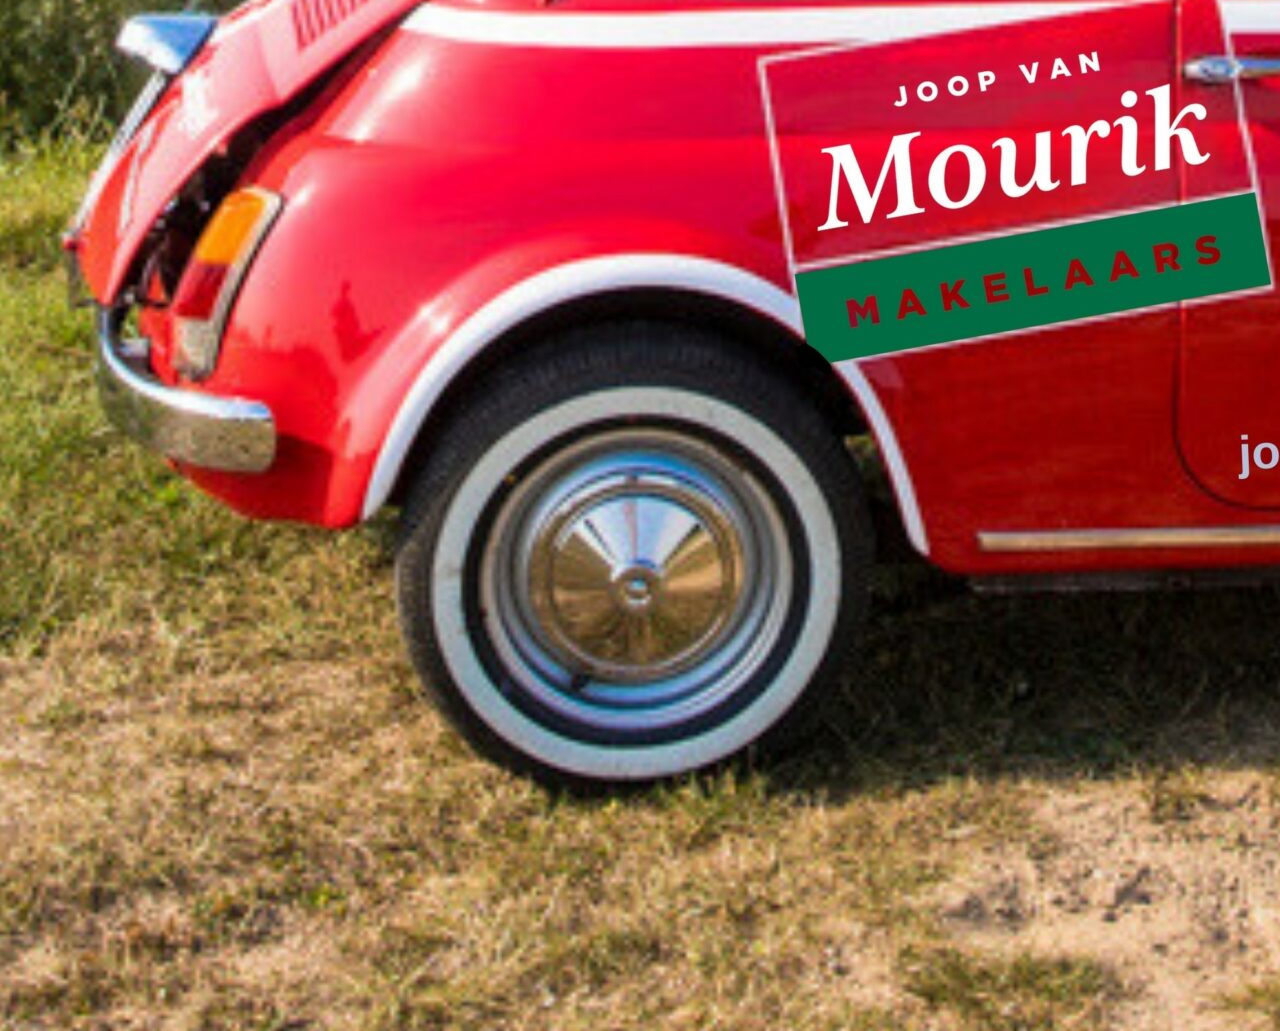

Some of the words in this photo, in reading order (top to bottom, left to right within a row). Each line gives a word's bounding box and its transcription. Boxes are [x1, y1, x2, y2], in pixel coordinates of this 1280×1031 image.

[894, 70, 997, 107] JOOP
[1017, 50, 1102, 84] VAN
[817, 83, 1211, 231] Mourik
[845, 234, 1222, 329] MAKELAARS
